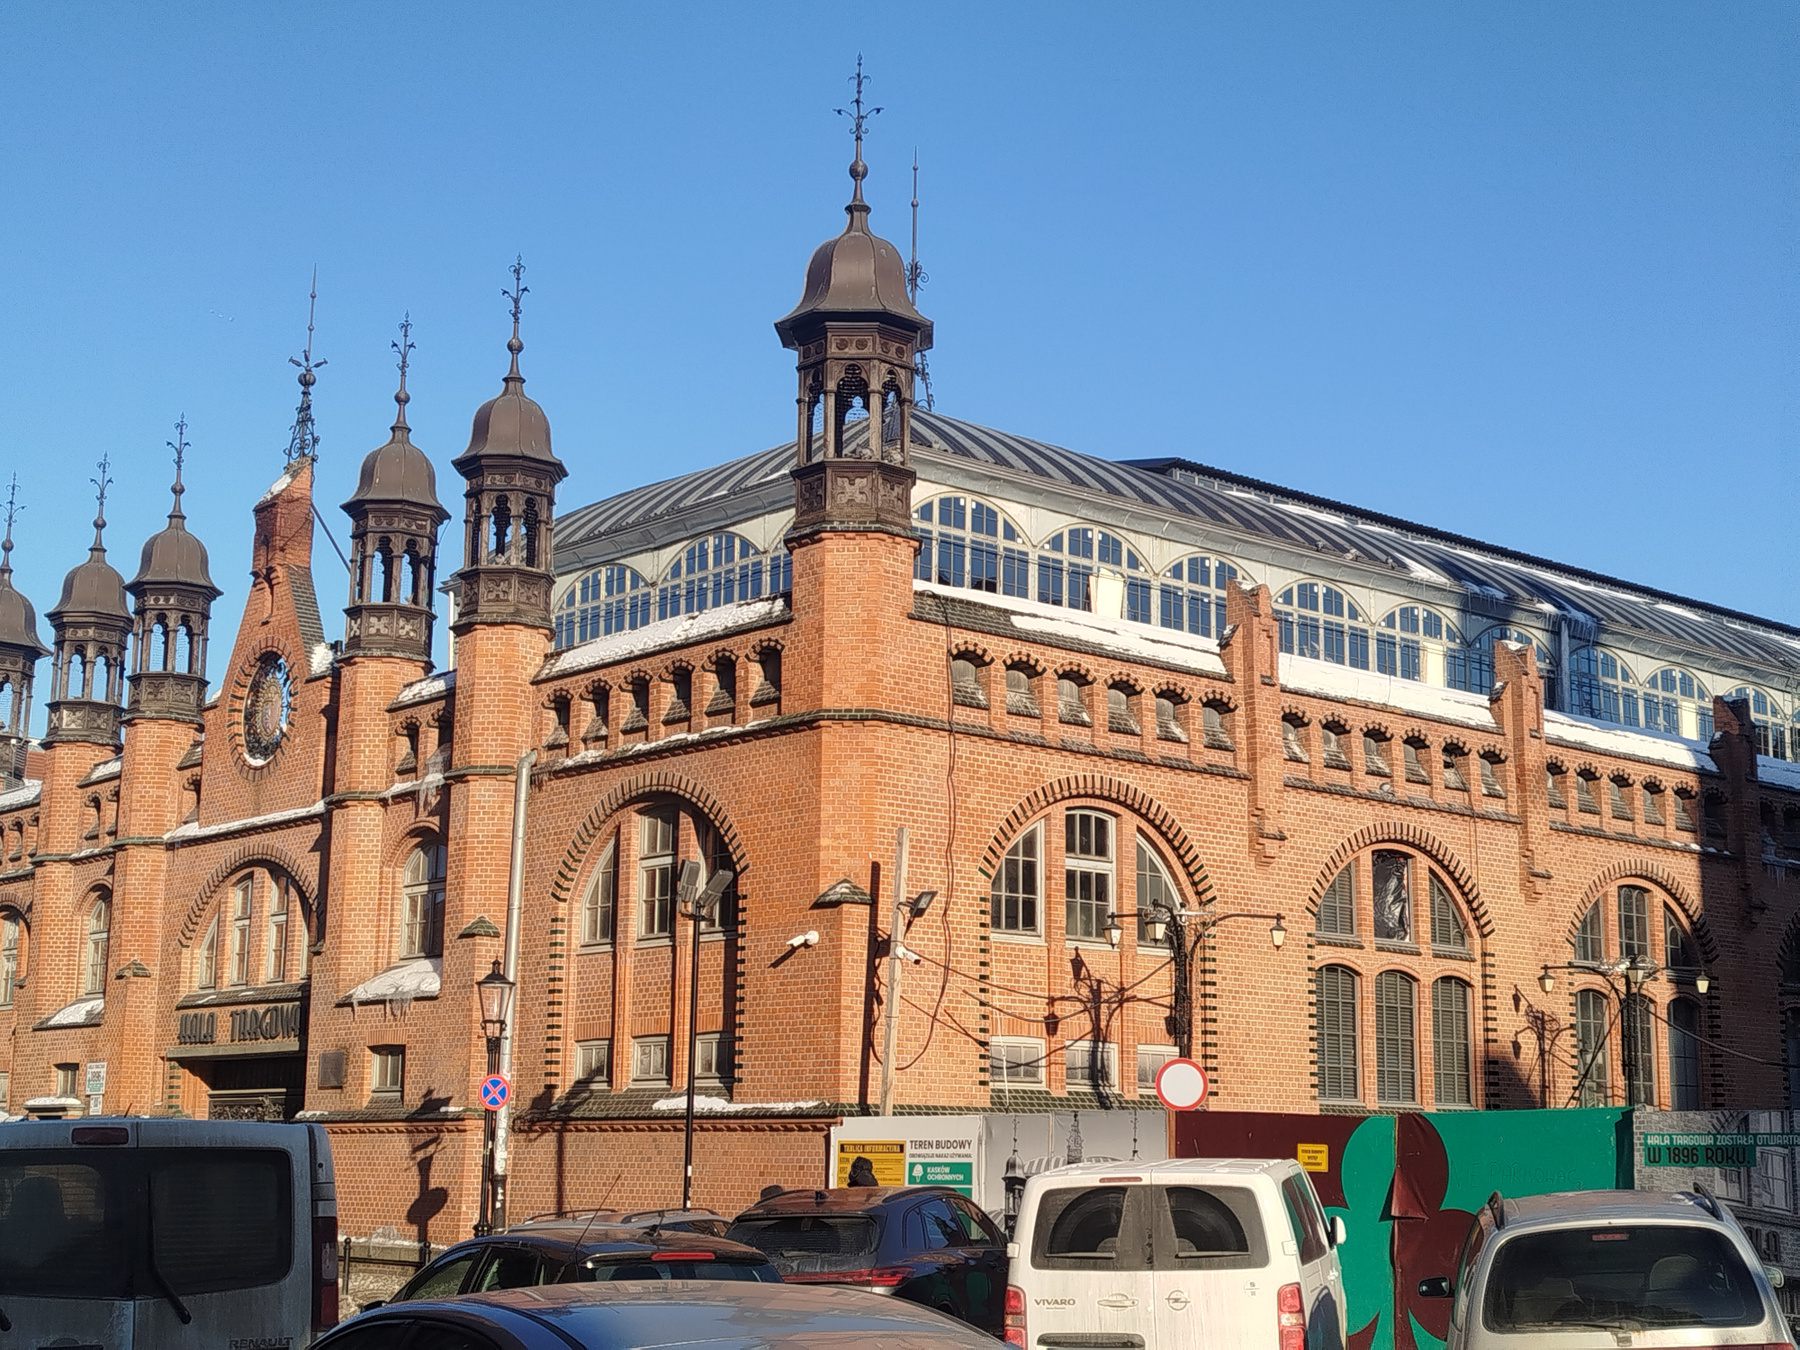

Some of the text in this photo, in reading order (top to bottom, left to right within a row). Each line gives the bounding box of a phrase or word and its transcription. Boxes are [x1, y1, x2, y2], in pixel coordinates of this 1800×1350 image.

[178, 1004, 300, 1045] HALA TARGOWA
[909, 1139, 973, 1150] TEREN BUDOWY
[1646, 1135, 1800, 1145] HALA TARGOWA ZOSTAŁA OTWARTA
[1647, 1147, 1661, 1164] W
[1667, 1147, 1699, 1164] 1896
[927, 1165, 950, 1173] KASKÓW
[1034, 1298, 1076, 1306] VIVARO
[229, 1336, 294, 1349] RENAULT
